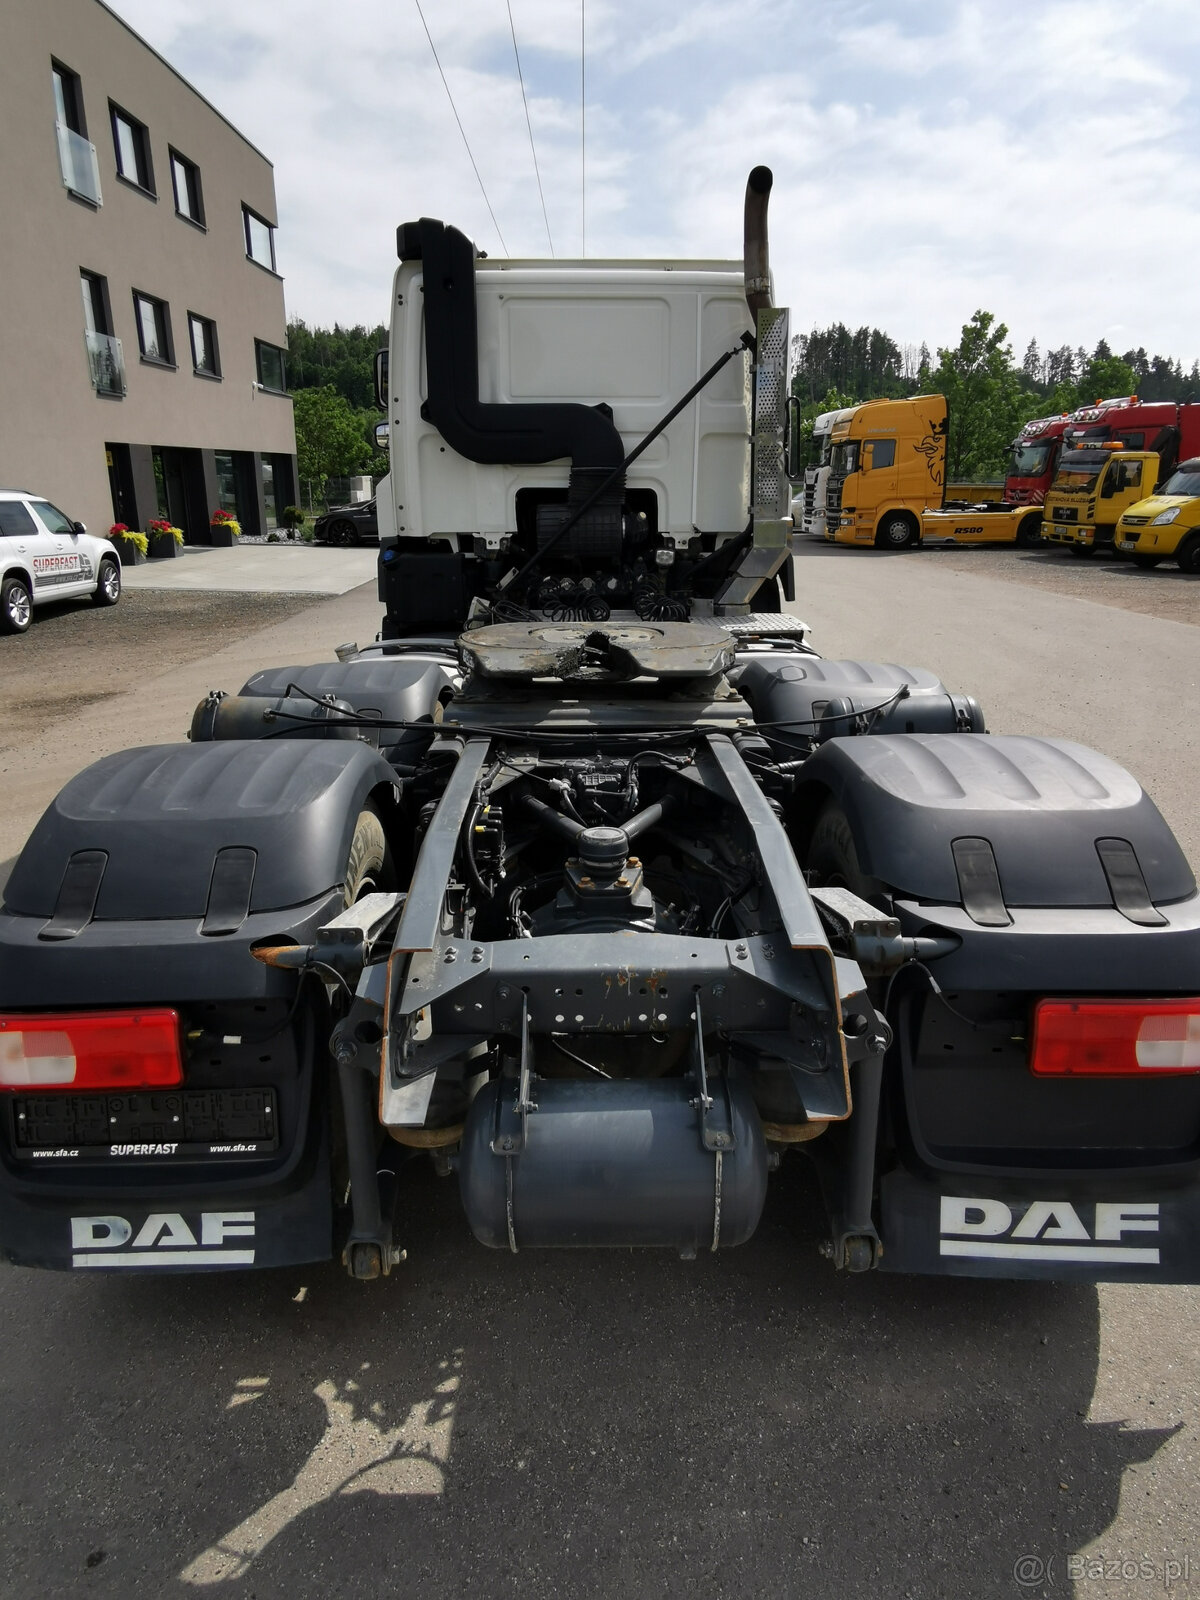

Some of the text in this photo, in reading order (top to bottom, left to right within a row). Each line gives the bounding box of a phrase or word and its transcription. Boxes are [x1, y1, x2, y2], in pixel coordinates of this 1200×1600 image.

[33, 1148, 79, 1158] www.sfa.cz
[110, 1143, 179, 1156] SUPERFAST
[210, 1143, 257, 1153] www.sfa.cz
[940, 1195, 1160, 1241] DAF
[70, 1211, 256, 1249] DAF
